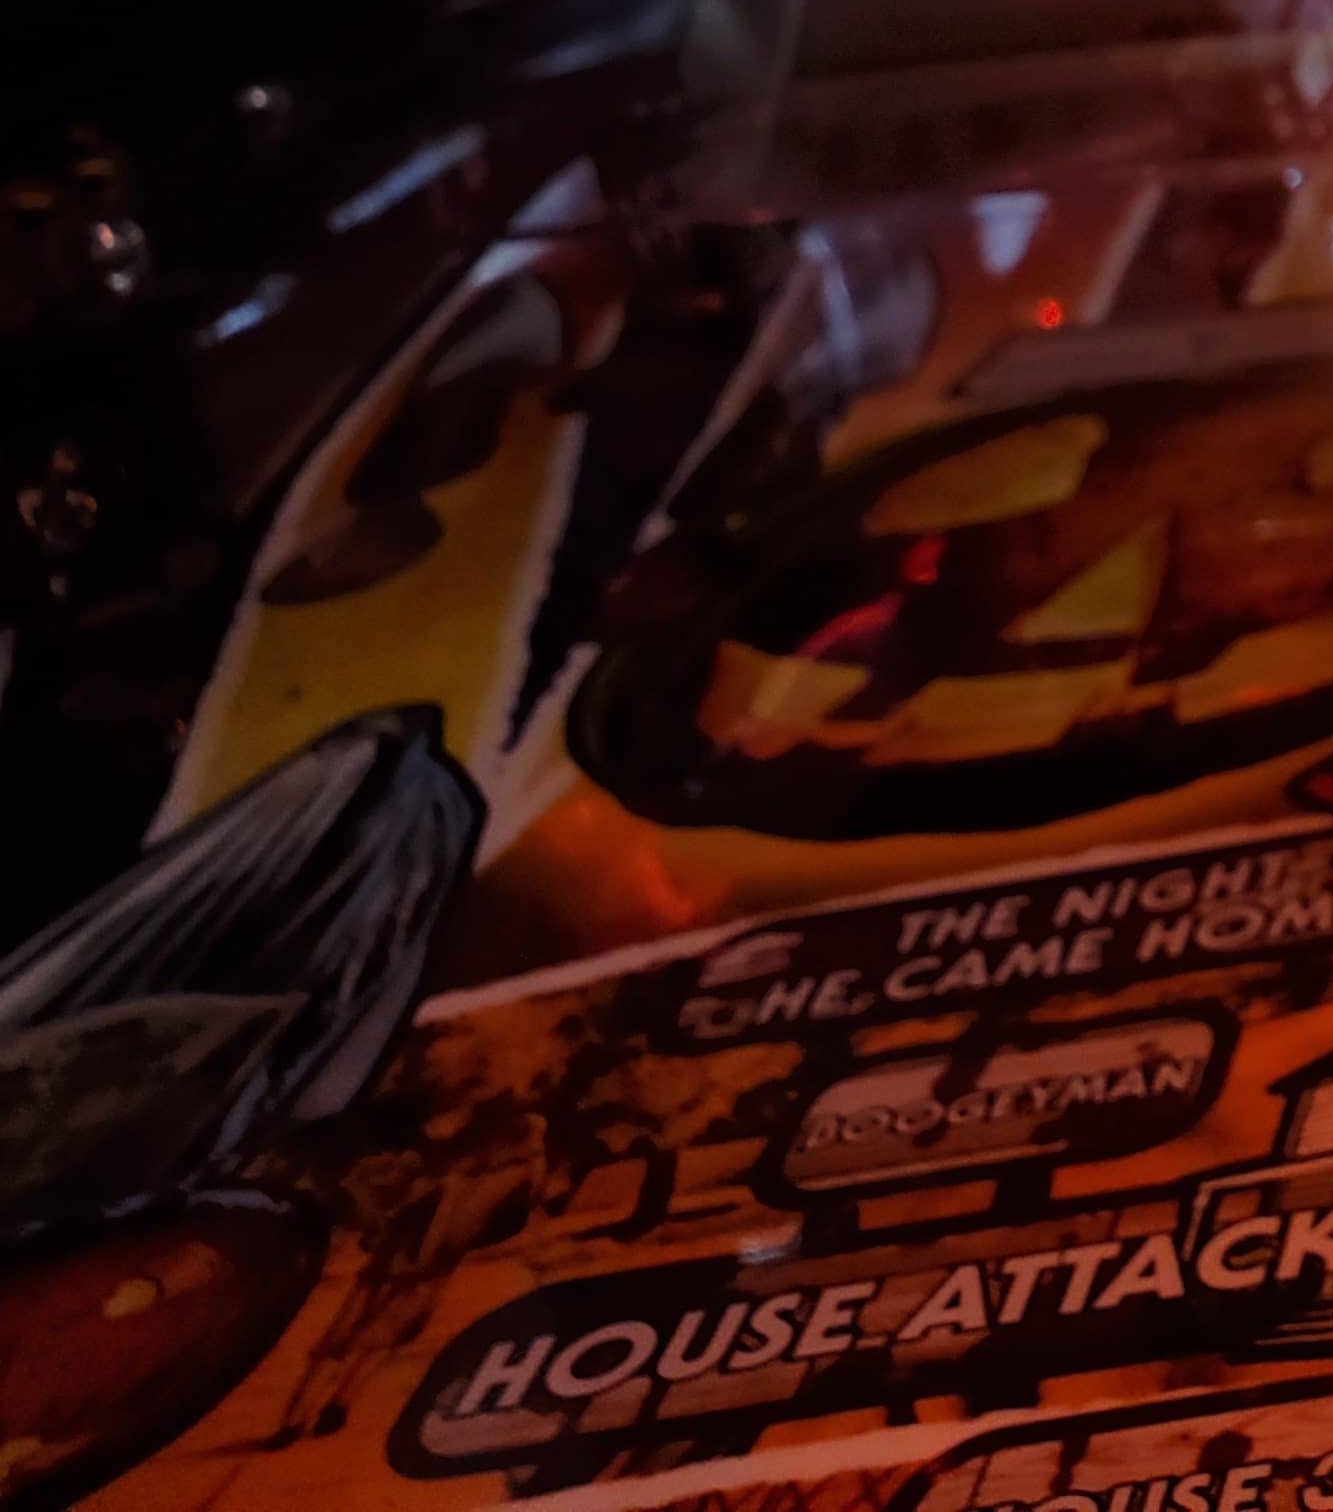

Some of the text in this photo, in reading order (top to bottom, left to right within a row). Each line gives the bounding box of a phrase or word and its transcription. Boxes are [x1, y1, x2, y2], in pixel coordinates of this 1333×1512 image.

[896, 846, 1300, 955] THE NIGHT
[883, 925, 1114, 1002] CAME
[463, 1282, 872, 1413] HOUSE
